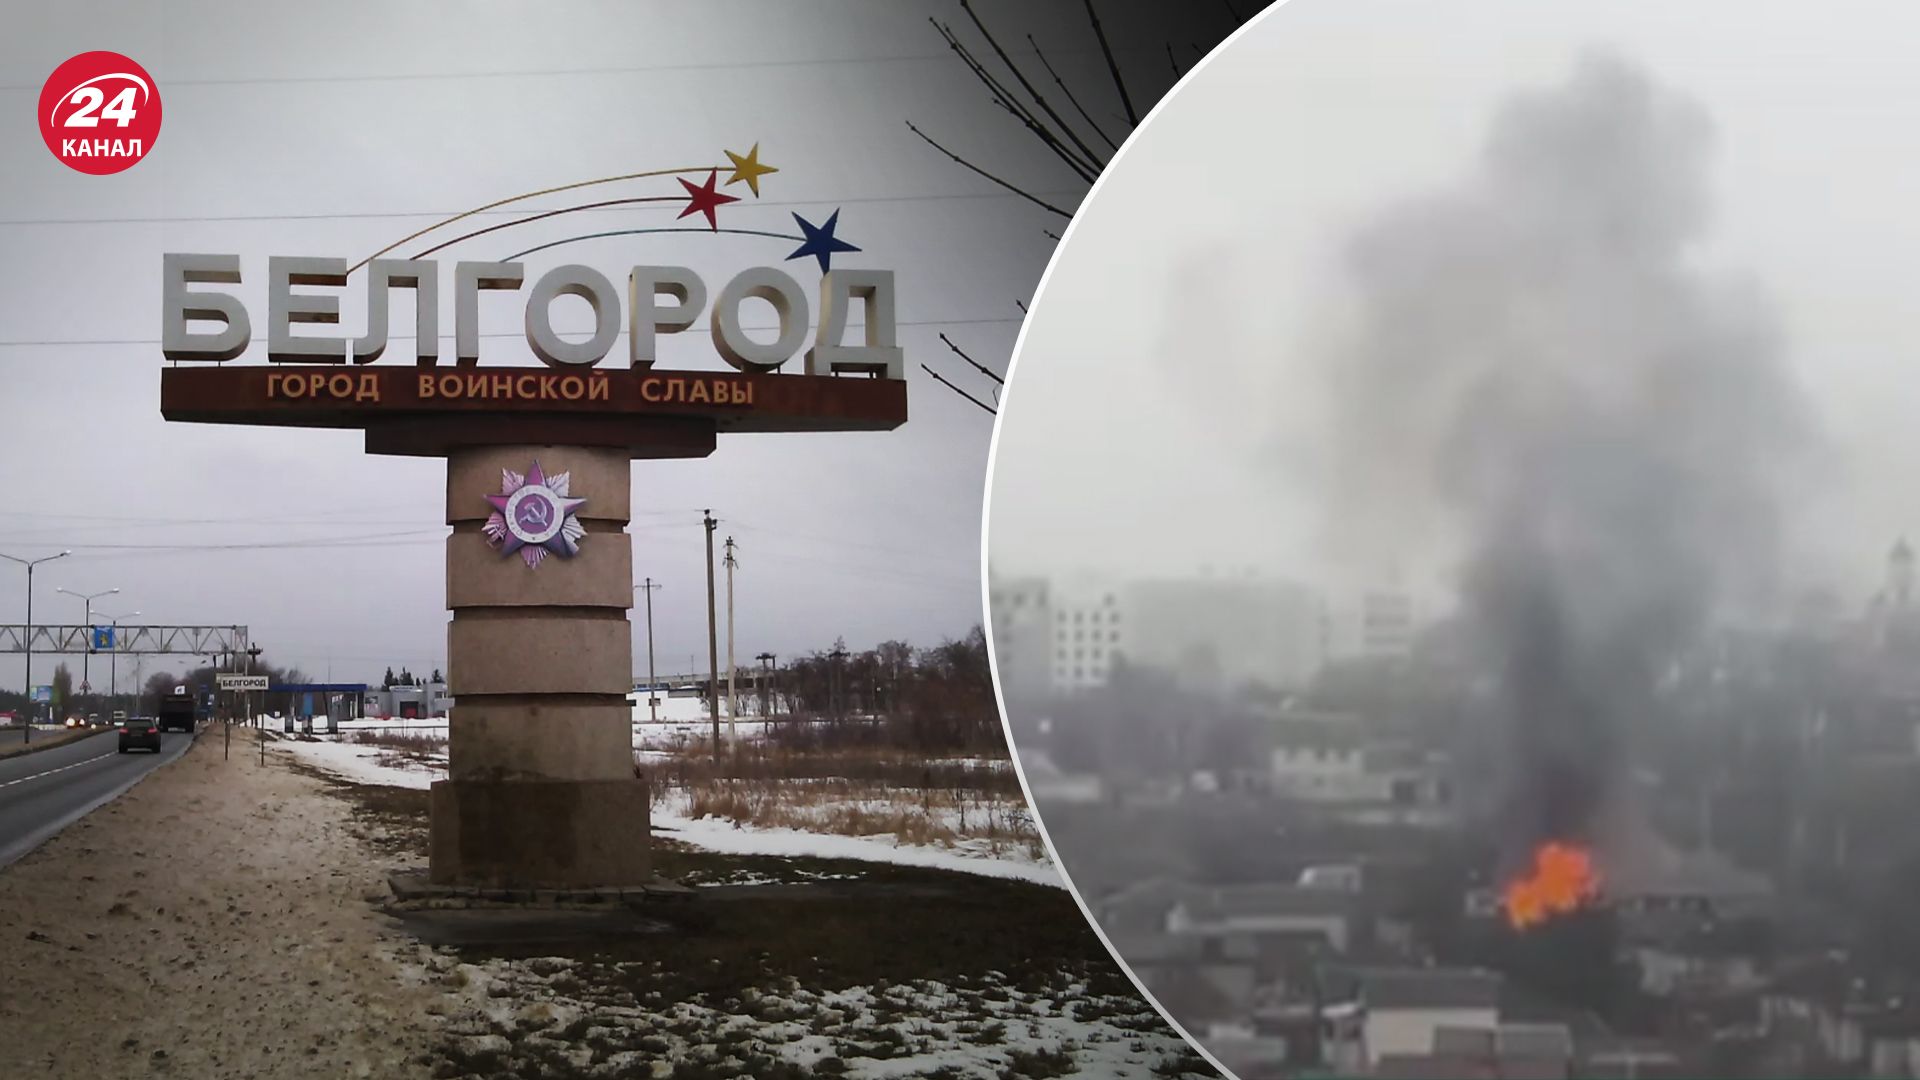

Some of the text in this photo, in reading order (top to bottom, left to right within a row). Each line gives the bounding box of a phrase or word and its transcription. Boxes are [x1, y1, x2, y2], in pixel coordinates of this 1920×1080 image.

[162, 253, 904, 379] БЕЛГОРОД
[267, 371, 754, 404] ГОРОД ВОИНСКОЙ СЛАВЫ
[222, 679, 266, 687] БЕЛГОРОД
